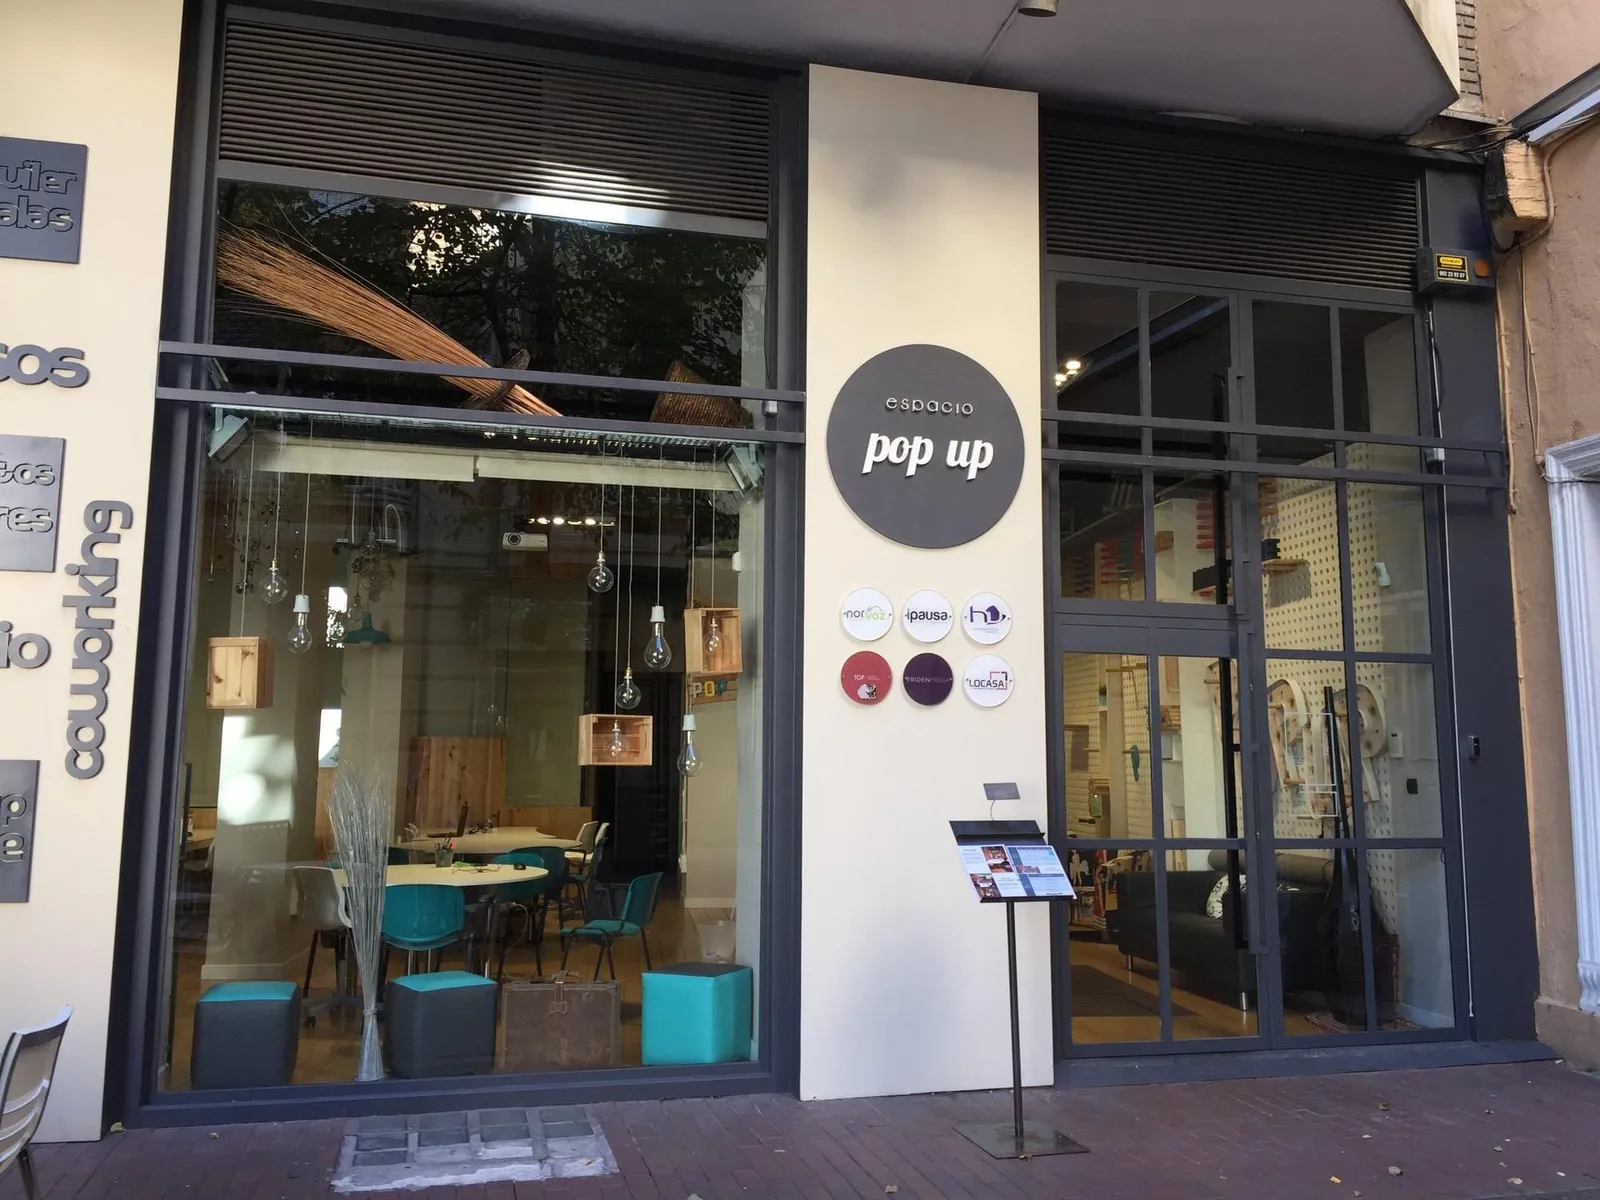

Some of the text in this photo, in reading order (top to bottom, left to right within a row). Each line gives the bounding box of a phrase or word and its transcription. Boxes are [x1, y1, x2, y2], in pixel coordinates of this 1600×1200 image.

[885, 397, 974, 415] espacio
[861, 432, 994, 481] pop up
[907, 608, 948, 623] ipausa
[62, 499, 134, 780] coworking
[969, 679, 1005, 688] LOCASA
